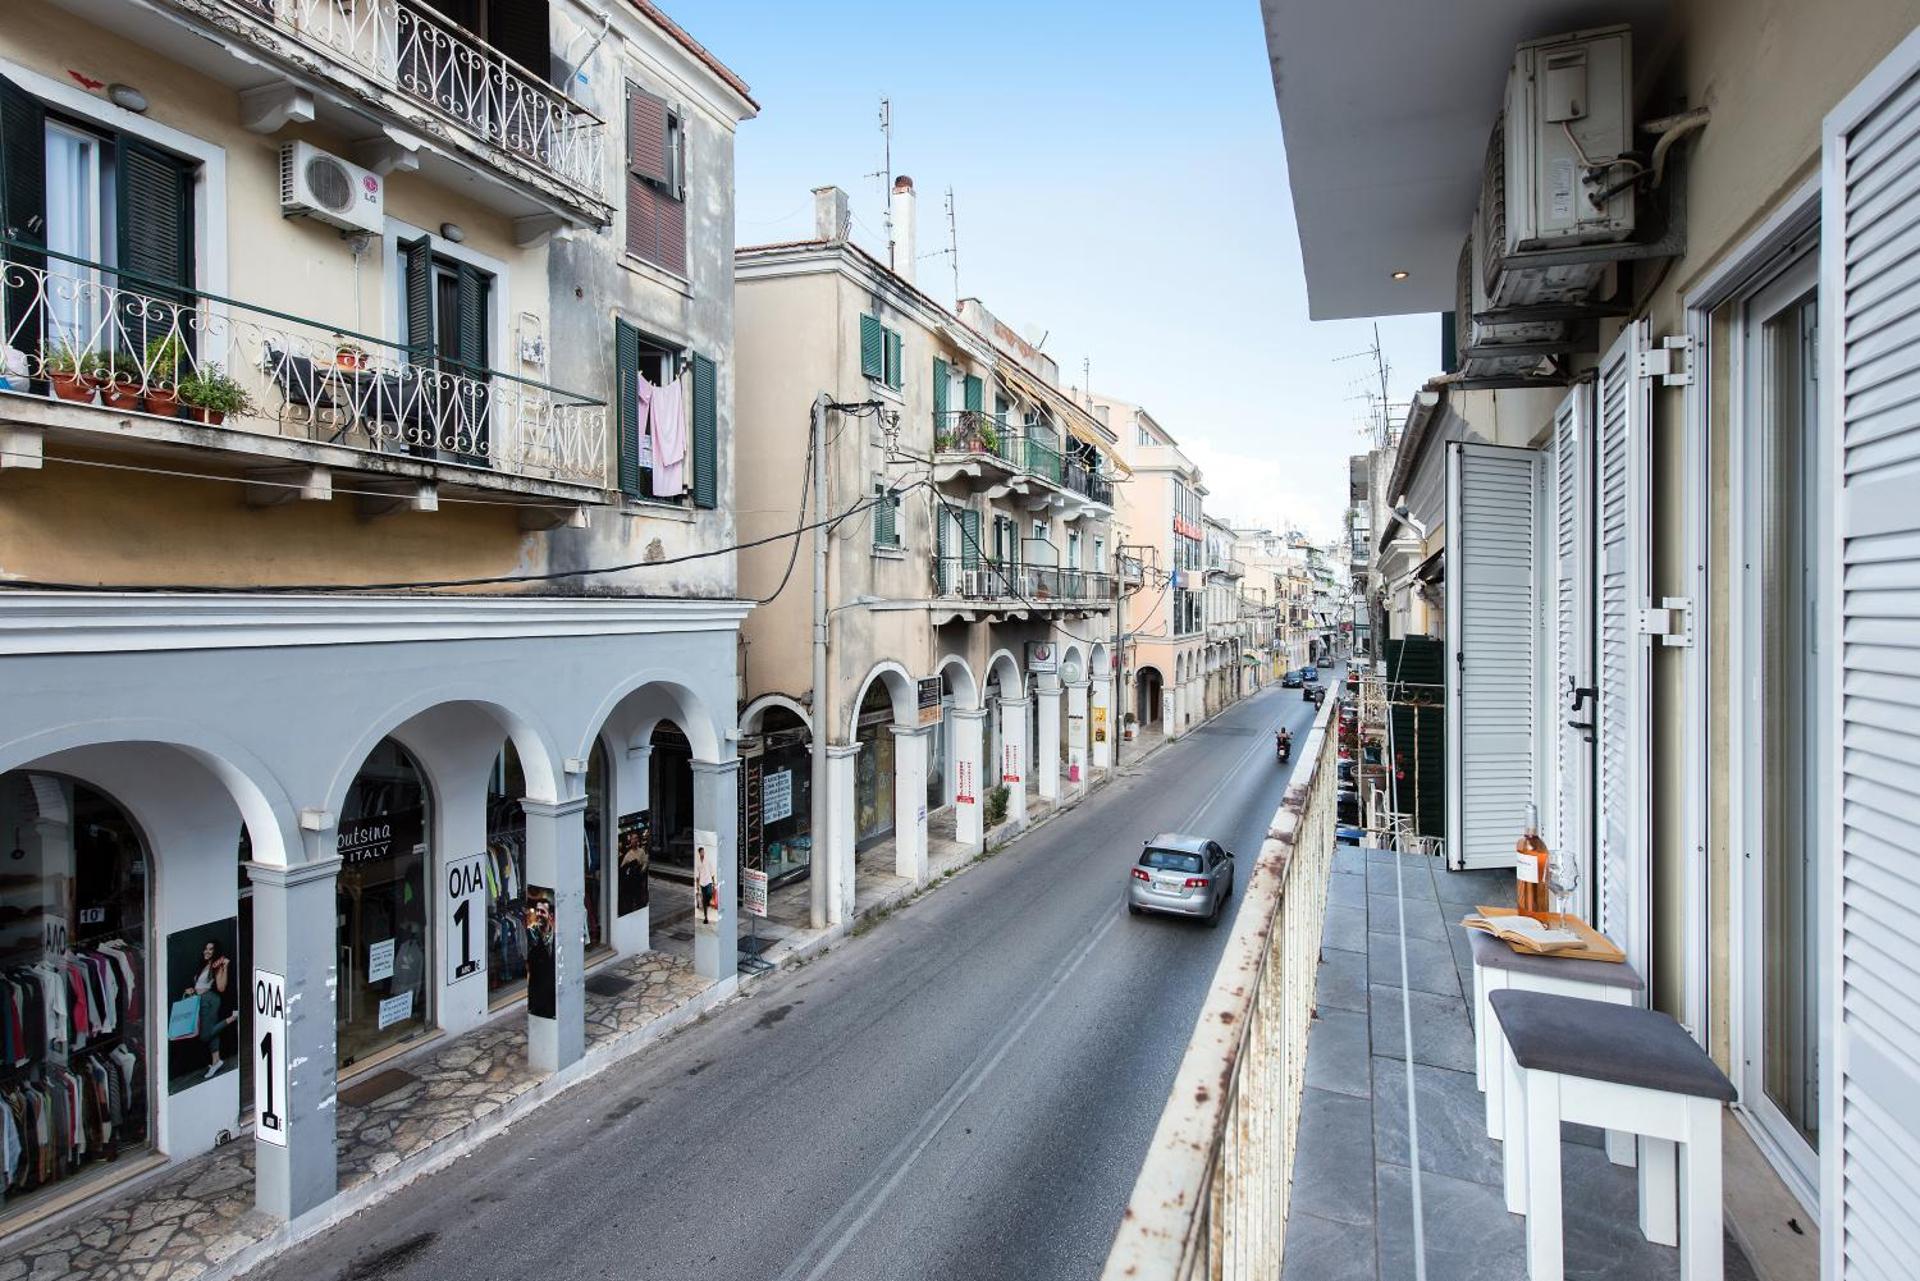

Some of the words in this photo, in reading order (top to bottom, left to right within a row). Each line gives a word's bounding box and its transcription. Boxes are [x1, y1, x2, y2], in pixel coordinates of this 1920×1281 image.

[364, 192, 376, 204] LG
[350, 844, 389, 862] ITALY
[449, 861, 484, 899] ΟΛΑ
[256, 980, 284, 1020] ΟΛΑ
